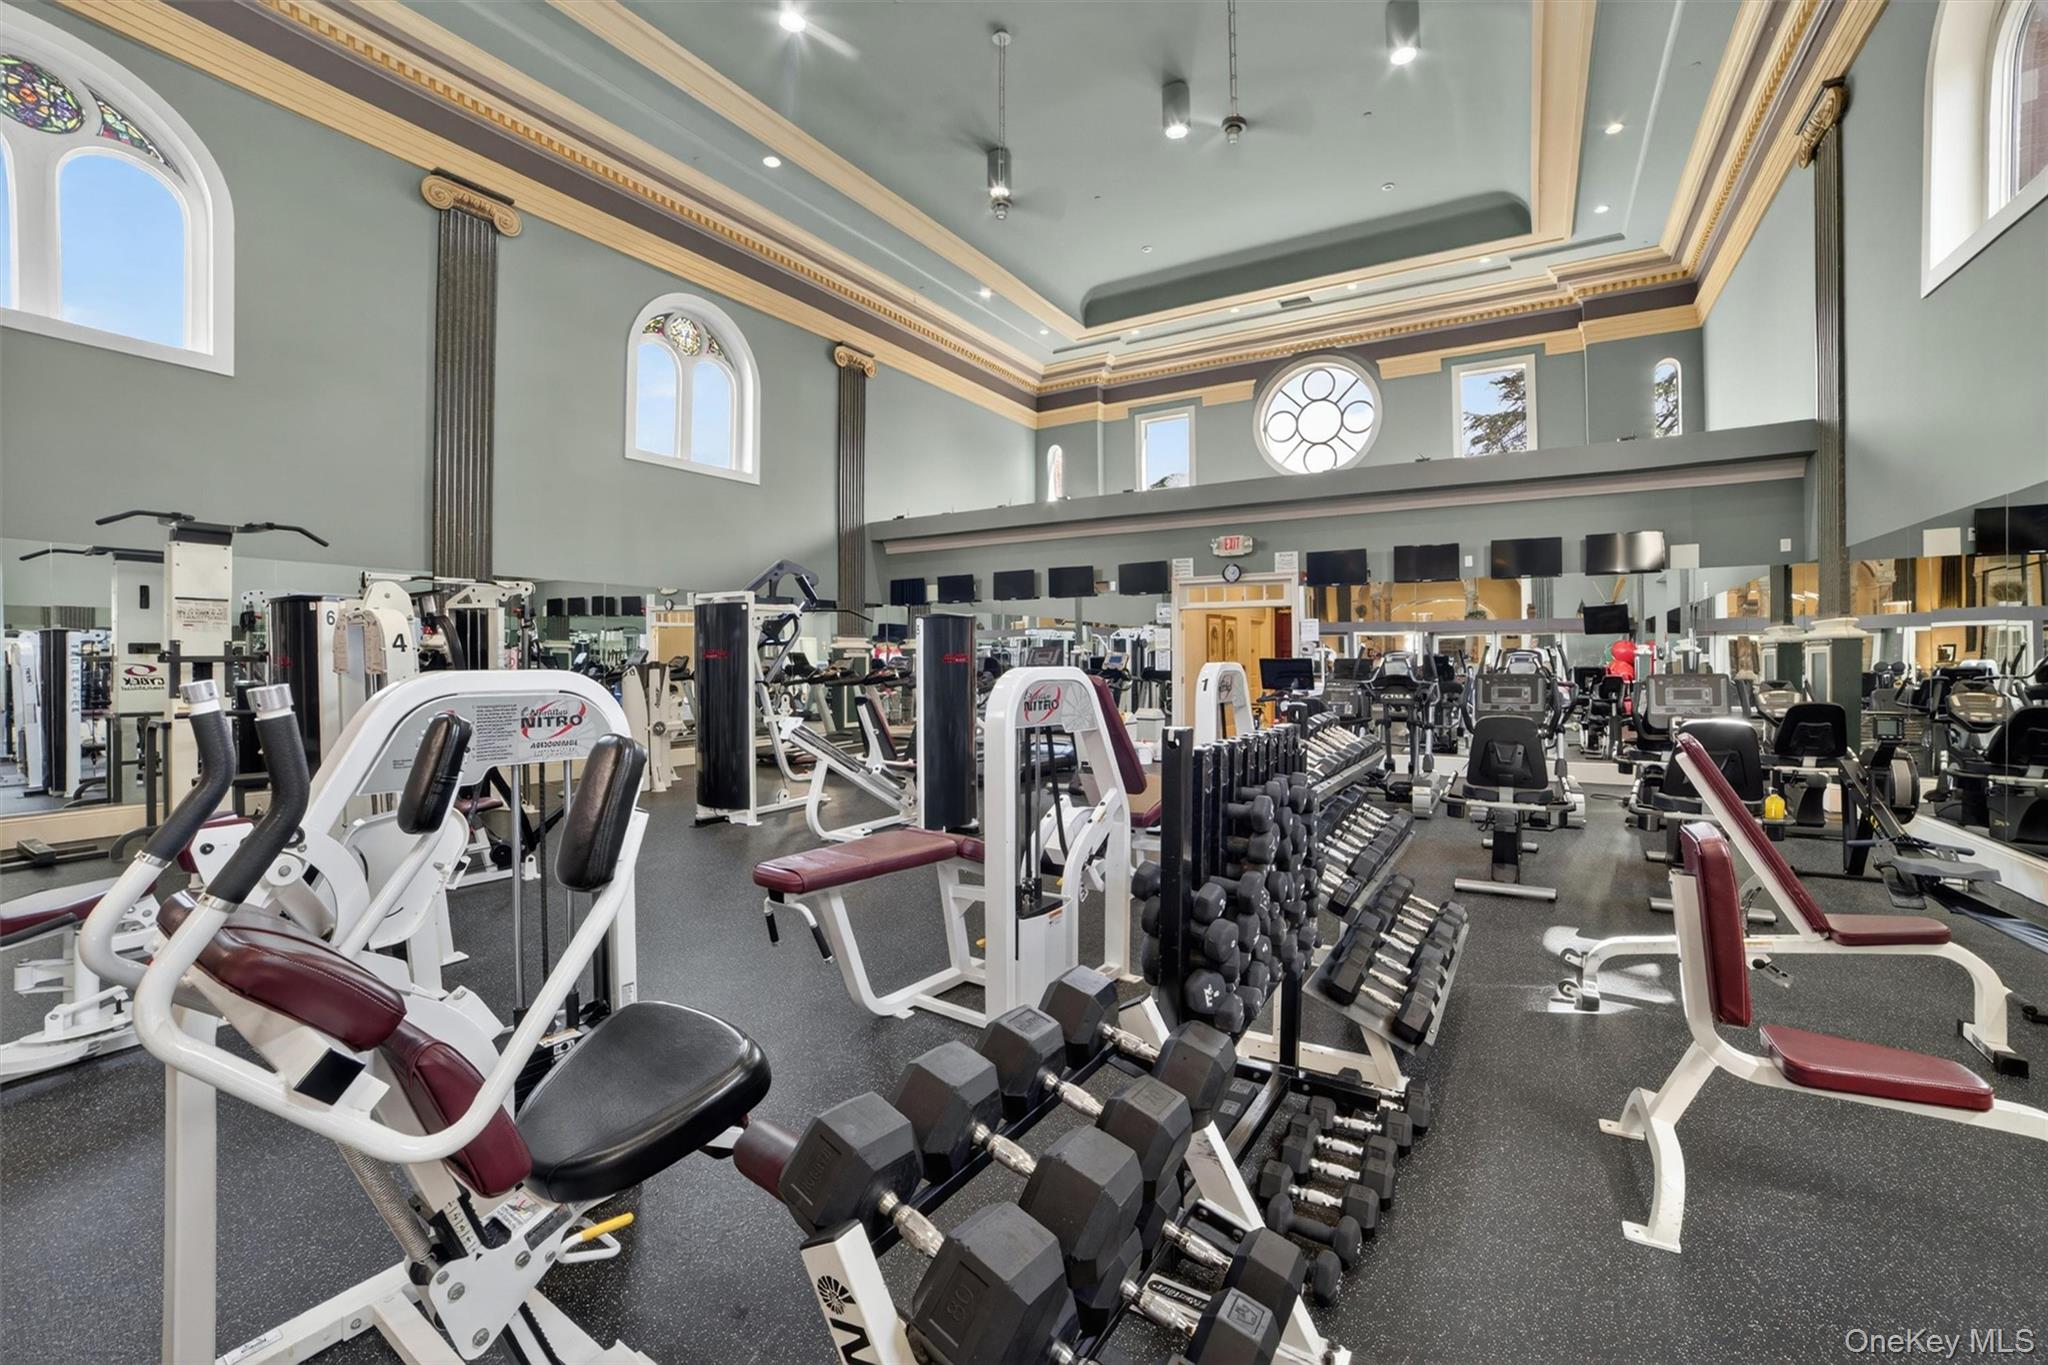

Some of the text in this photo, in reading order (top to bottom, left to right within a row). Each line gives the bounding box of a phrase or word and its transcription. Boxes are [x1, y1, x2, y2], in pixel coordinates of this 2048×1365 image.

[1224, 537, 1240, 551] EXIT
[326, 610, 336, 626] 6
[392, 633, 408, 653] 4
[1201, 678, 1209, 692] 1
[1023, 699, 1059, 712] NITRO
[520, 714, 583, 729] NITRO
